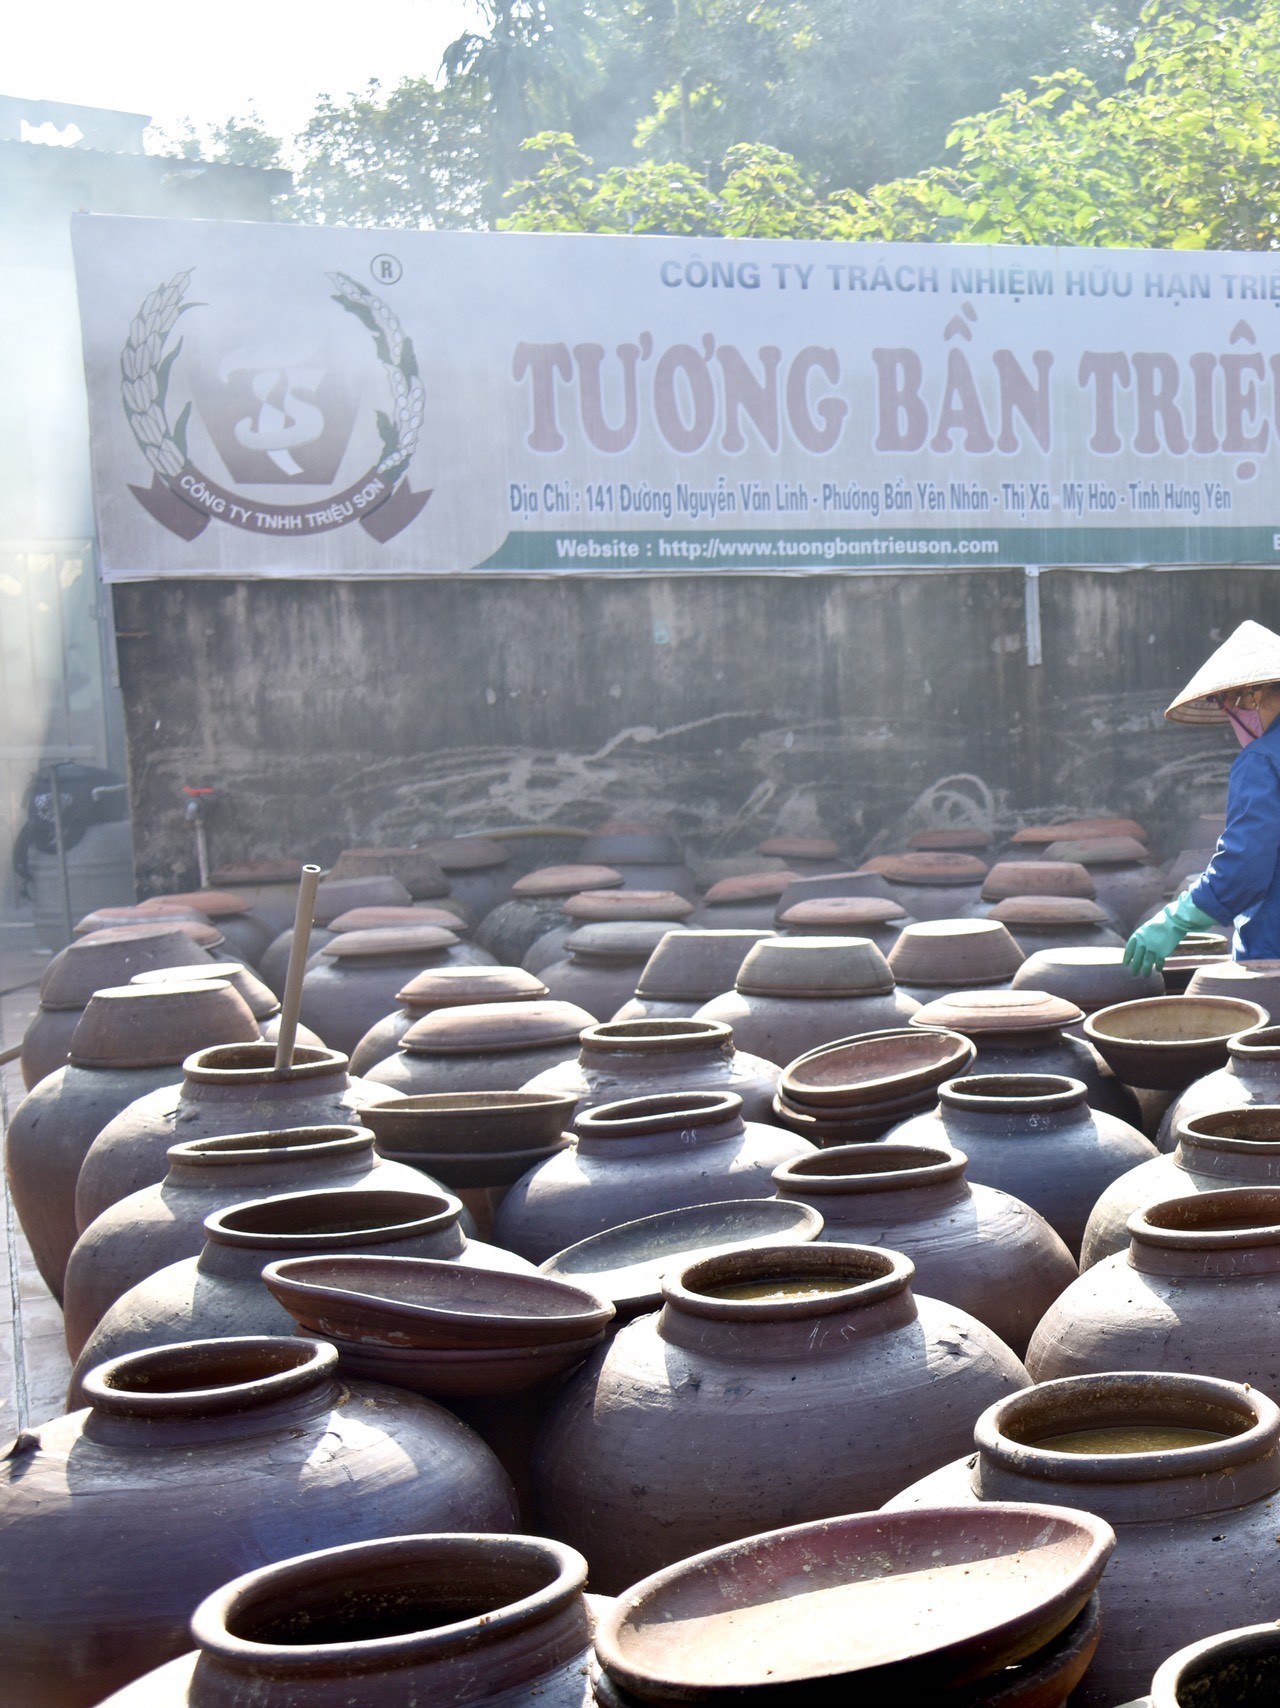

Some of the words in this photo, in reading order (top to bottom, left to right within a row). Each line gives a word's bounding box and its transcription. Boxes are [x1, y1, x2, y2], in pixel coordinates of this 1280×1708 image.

[660, 253, 761, 289] CÔNG
[771, 263, 814, 290] TY
[826, 258, 939, 292] TRÁCH
[951, 263, 1053, 303] NHIỆM
[1066, 264, 1132, 297] HỮU
[1145, 272, 1211, 306] HẠN
[512, 331, 848, 455] TƯƠNG
[872, 301, 1054, 455] BẦN
[180, 475, 225, 513] CÔNG
[229, 504, 252, 523] TY
[255, 512, 302, 529] TNHH
[305, 502, 353, 527] TRIỆU
[353, 478, 385, 509] SƠN
[510, 483, 538, 520] Địa
[543, 481, 570, 512] Chỉ
[586, 485, 613, 512] 141
[620, 482, 672, 518] Đường
[676, 477, 736, 518] Nguyễn
[740, 484, 771, 512] Văn
[776, 483, 808, 511] Linh
[822, 482, 879, 517] Phường
[917, 483, 946, 511] Yên
[950, 483, 989, 510] Nhân
[1002, 483, 1025, 517] Thị
[1030, 483, 1049, 510] Xã
[1063, 483, 1085, 516] Mỹ
[1089, 481, 1116, 510] Hào
[1165, 482, 1201, 515] Hưng
[1205, 481, 1231, 510] Yên
[556, 539, 640, 558] Website
[659, 536, 999, 561] http://www.tuongbantrieuson.com
